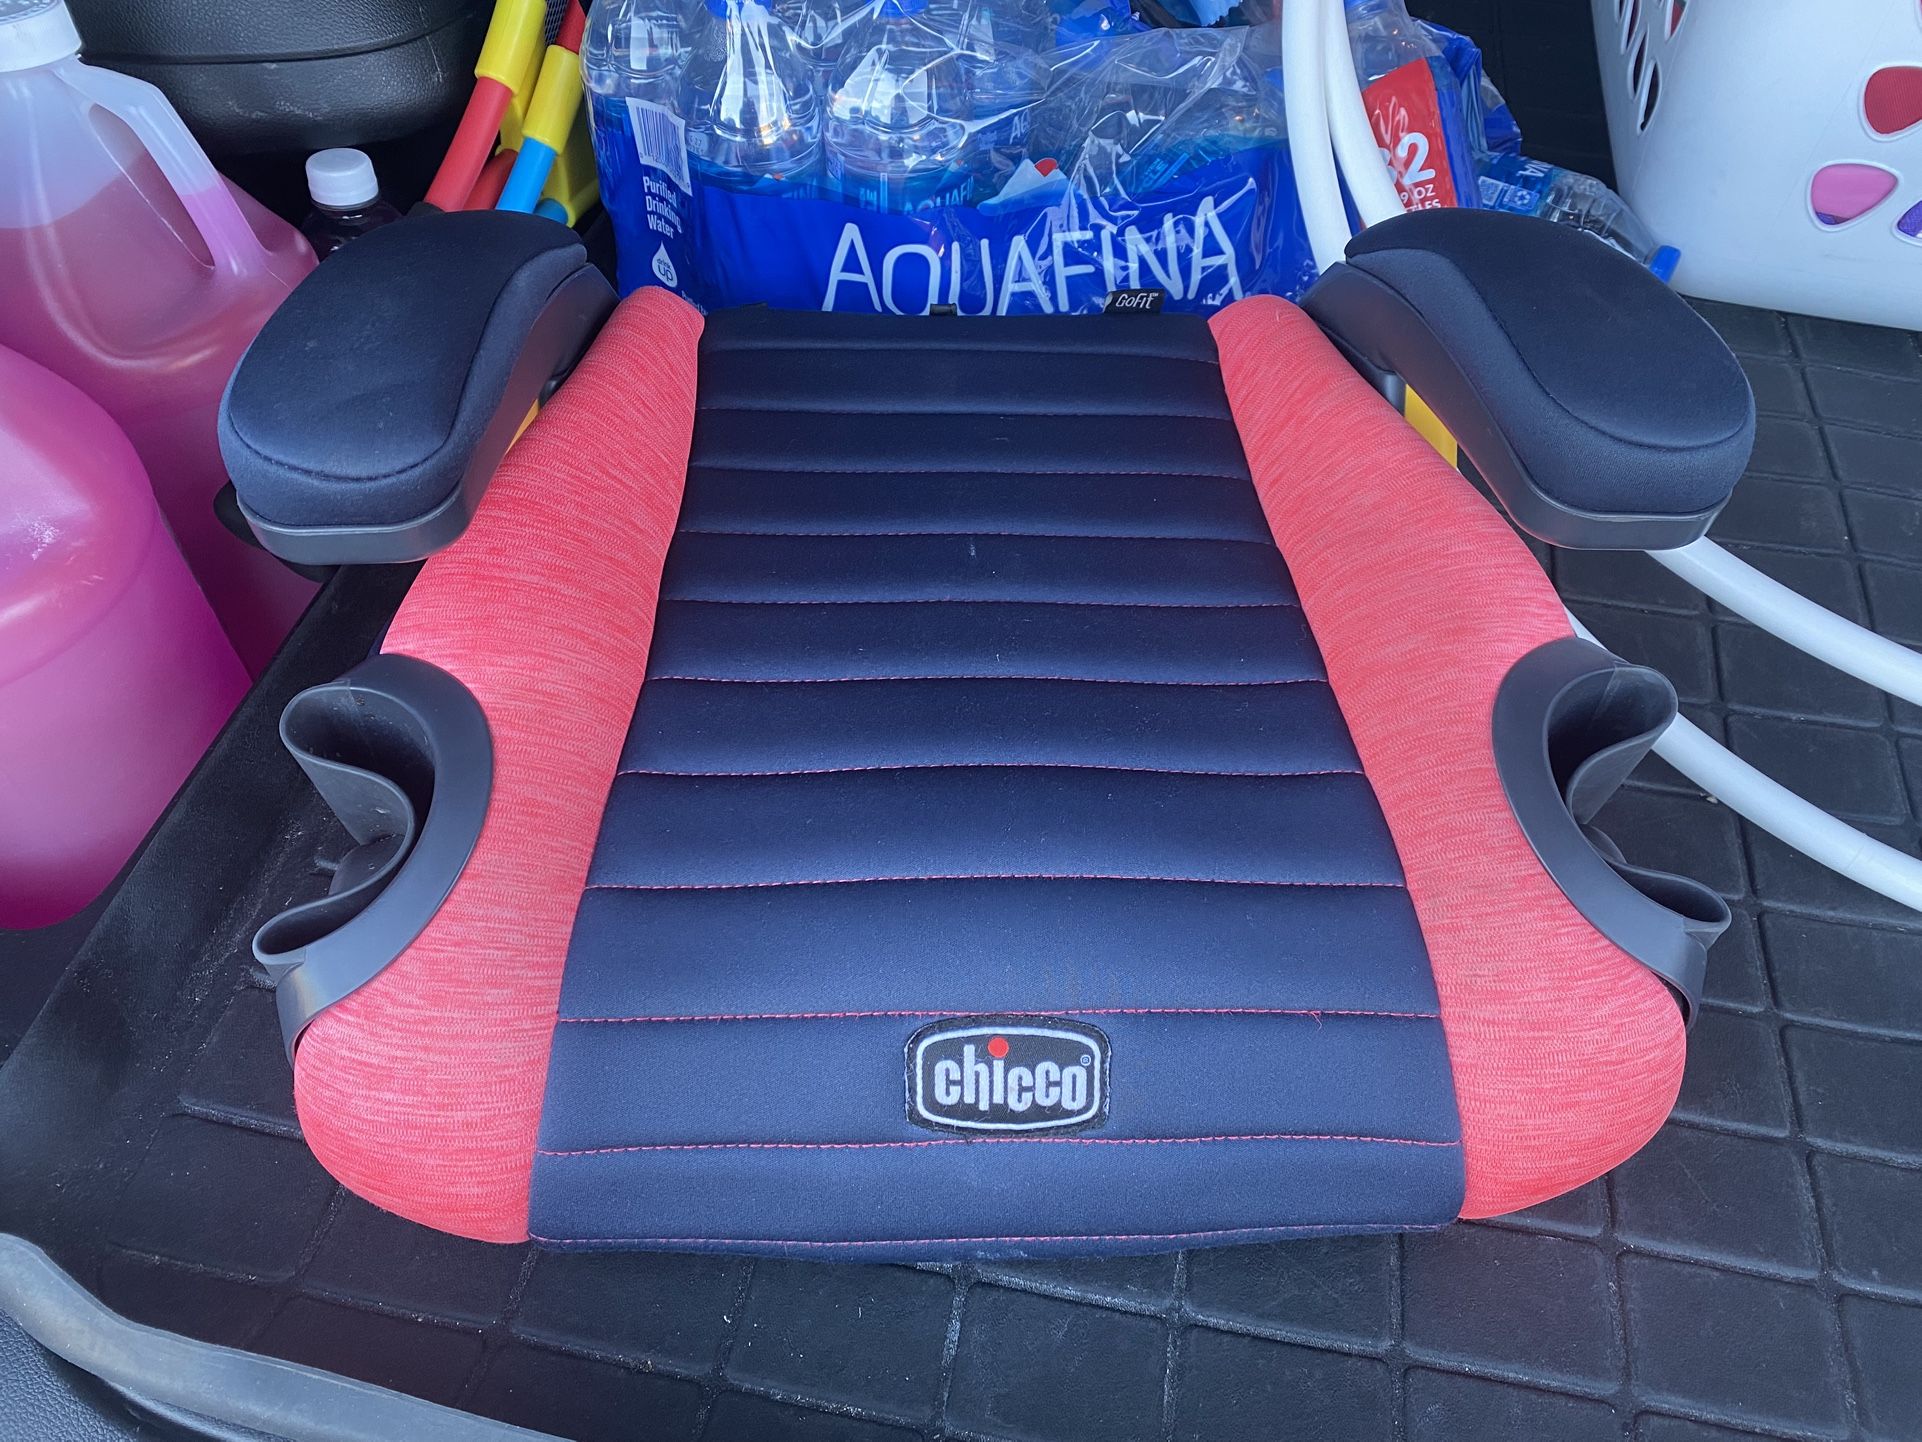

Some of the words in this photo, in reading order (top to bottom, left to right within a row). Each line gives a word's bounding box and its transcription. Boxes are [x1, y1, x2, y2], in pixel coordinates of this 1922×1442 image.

[643, 176, 677, 208] Purified
[1413, 184, 1436, 199] OZ
[645, 195, 682, 234] Drinking
[647, 214, 674, 239] Water
[821, 196, 1244, 317] AQUAFINA
[934, 1036, 1088, 1112] chicco
